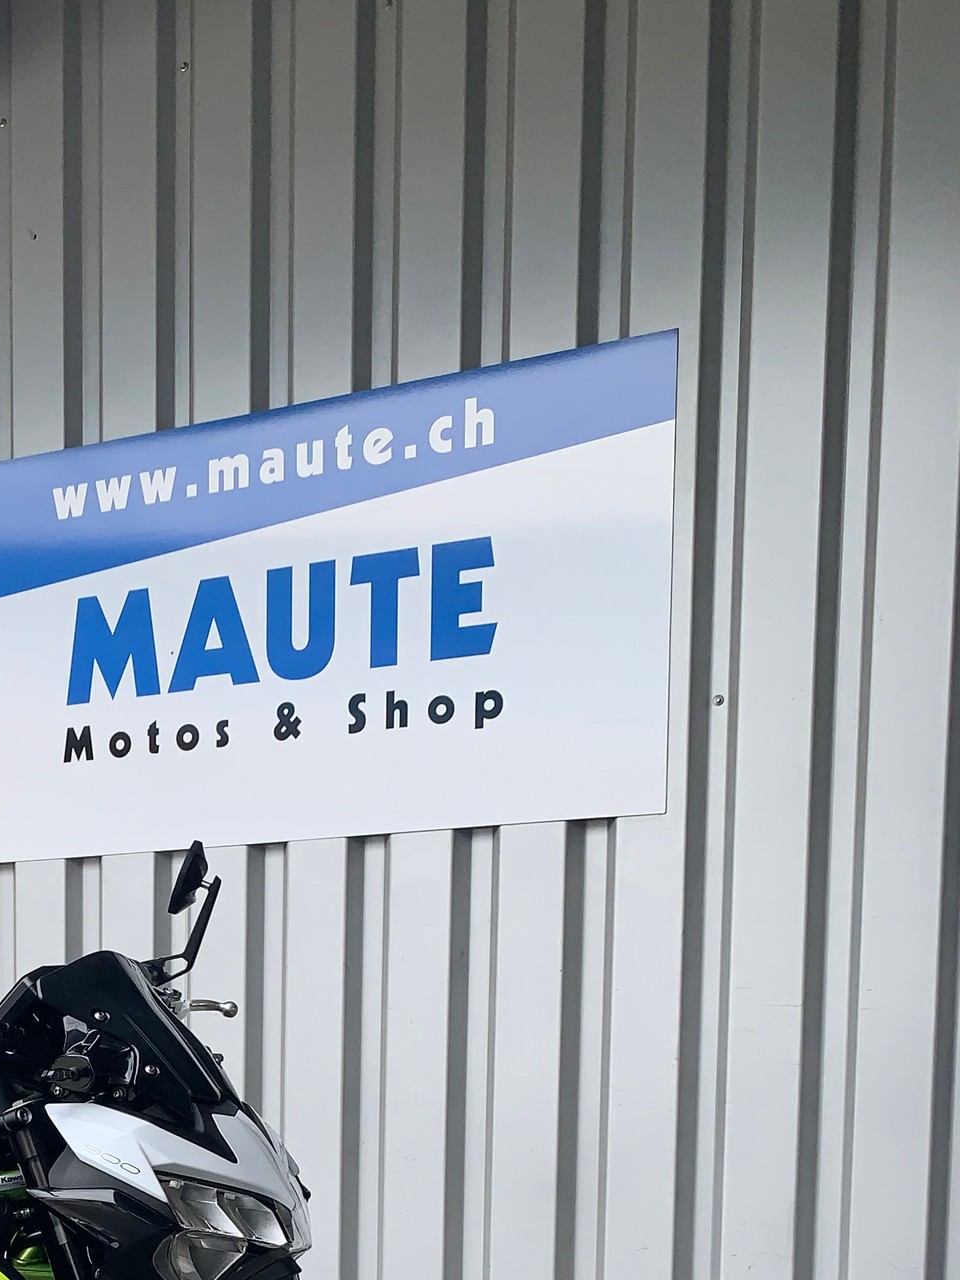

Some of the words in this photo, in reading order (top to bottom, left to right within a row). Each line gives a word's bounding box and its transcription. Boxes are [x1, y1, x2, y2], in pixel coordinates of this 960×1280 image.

[52, 396, 496, 520] www.maute.ch
[66, 536, 498, 706] MAUTE
[63, 719, 230, 763] Motos
[273, 701, 302, 741] &
[348, 689, 504, 734] Shop
